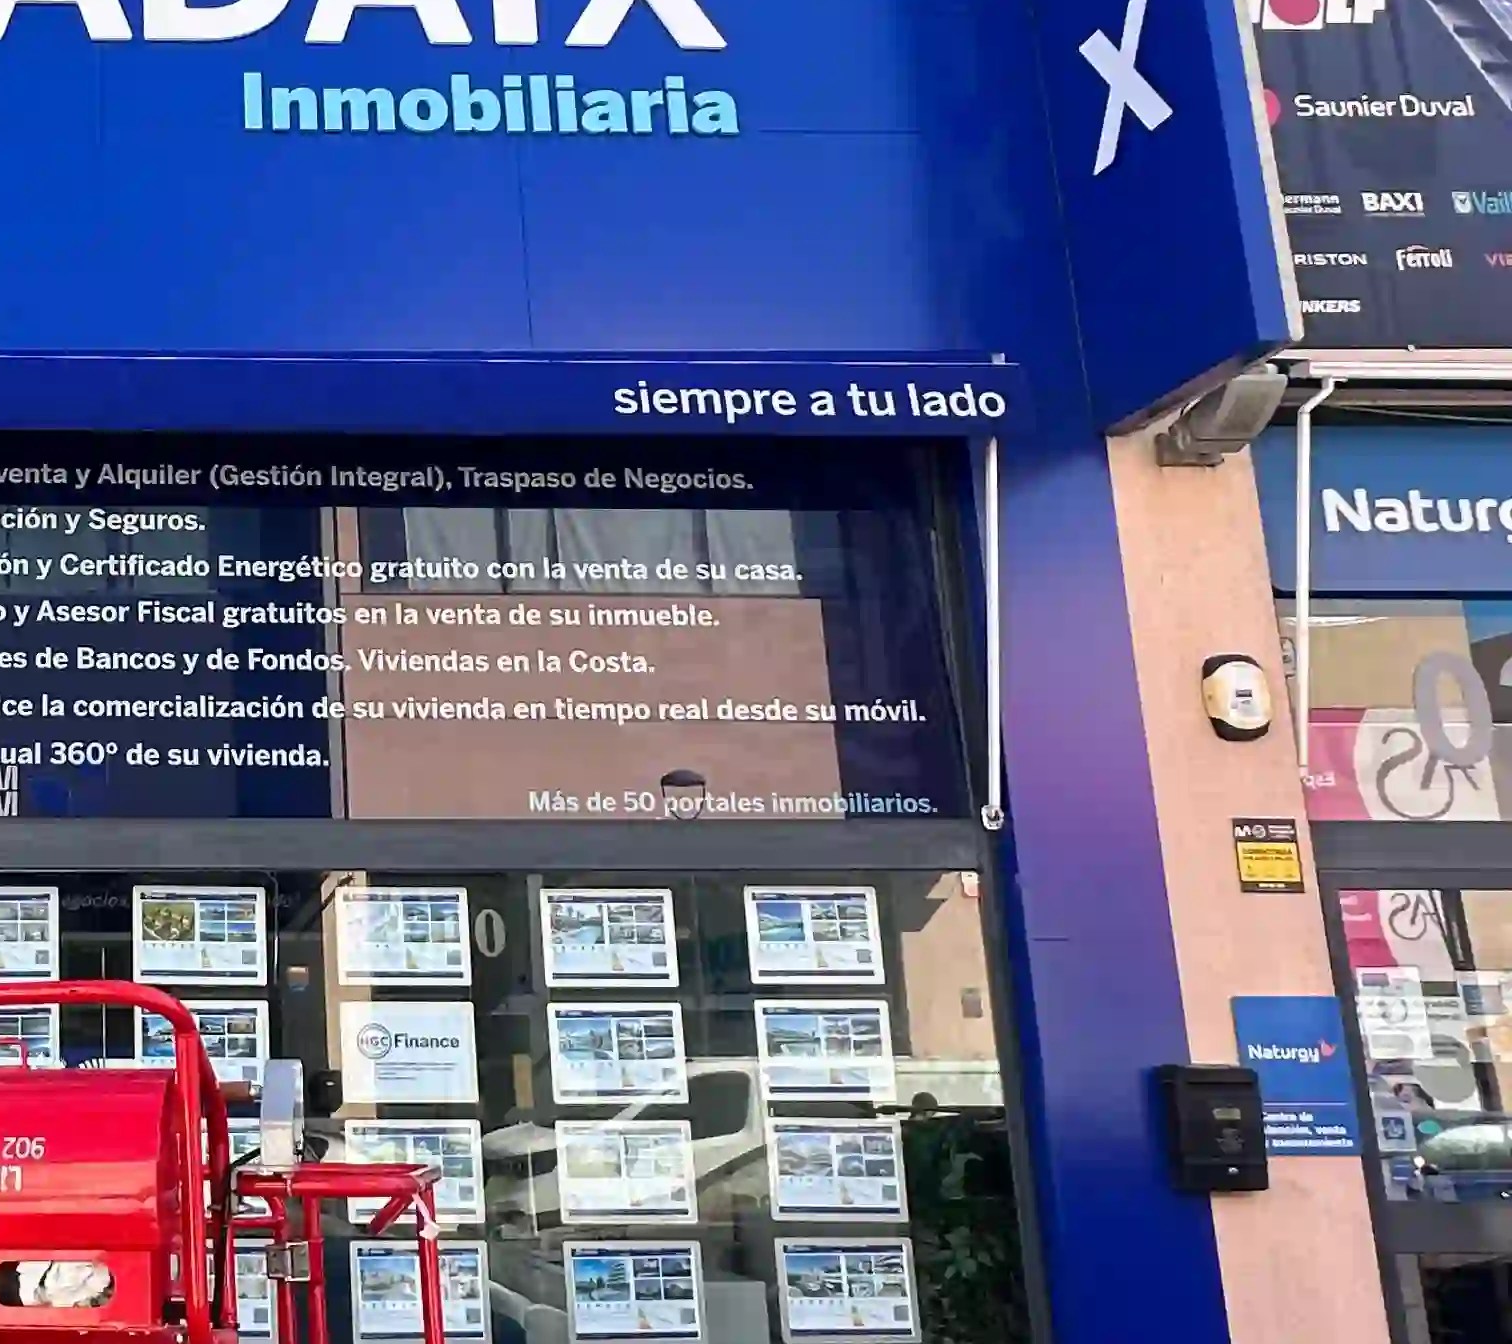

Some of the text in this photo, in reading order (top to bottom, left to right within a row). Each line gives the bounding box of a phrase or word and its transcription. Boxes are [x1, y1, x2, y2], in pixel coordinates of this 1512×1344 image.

[242, 72, 739, 134] Inmobiliaria
[1294, 94, 1475, 118] Saunier Duval
[1284, 194, 1341, 205] ermann
[1361, 192, 1425, 212] BAXI
[1294, 253, 1368, 265] RISTON
[1300, 299, 1361, 313] NKERS
[614, 382, 1006, 422] siempre a tu lado
[75, 467, 91, 489] y
[98, 464, 201, 489] Alquiler
[209, 464, 322, 490] (Gestión
[331, 467, 452, 491] Integral),
[459, 466, 575, 492] Traspaso
[584, 468, 616, 489] de
[624, 469, 754, 492] Negocios.
[64, 513, 81, 534] y
[88, 510, 206, 534] Seguros.
[36, 559, 52, 579] y
[60, 554, 209, 578] Certificado
[218, 556, 363, 582] Energético
[370, 558, 479, 580] gratuito
[487, 561, 535, 580] con
[544, 559, 566, 580] la
[574, 562, 647, 581] venta
[655, 560, 689, 581] de
[696, 564, 726, 581] su
[734, 564, 803, 582] casa.
[14, 607, 30, 626] y
[37, 601, 129, 624] Asesor
[138, 601, 215, 624] Fiscal
[223, 602, 347, 628] gratuitos
[354, 607, 387, 625] en
[395, 604, 419, 625] la
[427, 607, 501, 626] venta
[508, 604, 542, 626] de
[549, 608, 581, 626] su
[588, 605, 720, 628] inmueble.
[35, 648, 68, 670] de
[76, 649, 176, 670] Bancos
[183, 655, 200, 675] y
[206, 650, 239, 671] de
[248, 650, 351, 672] Fondos.
[360, 651, 489, 674] Viviendas
[497, 656, 530, 674] en
[538, 652, 561, 674] la
[568, 652, 656, 675] Costa.
[41, 694, 65, 717] la
[73, 695, 304, 720] comercialización
[312, 697, 345, 719] de
[353, 702, 385, 719] su
[392, 698, 506, 720] vivienda
[513, 701, 547, 720] en
[554, 698, 651, 726] tiempo
[659, 700, 709, 721] real
[716, 700, 797, 721] desde
[805, 704, 837, 722] su
[844, 698, 926, 723] móvil.
[126, 743, 159, 766] de
[167, 749, 199, 766] su
[206, 743, 330, 767] vivienda.
[529, 791, 939, 817] Más de 50 portales inmobiliarios.
[393, 1033, 460, 1049] Finance
[1247, 1043, 1321, 1063] Naturgy
[2, 1136, 46, 1160] 902
